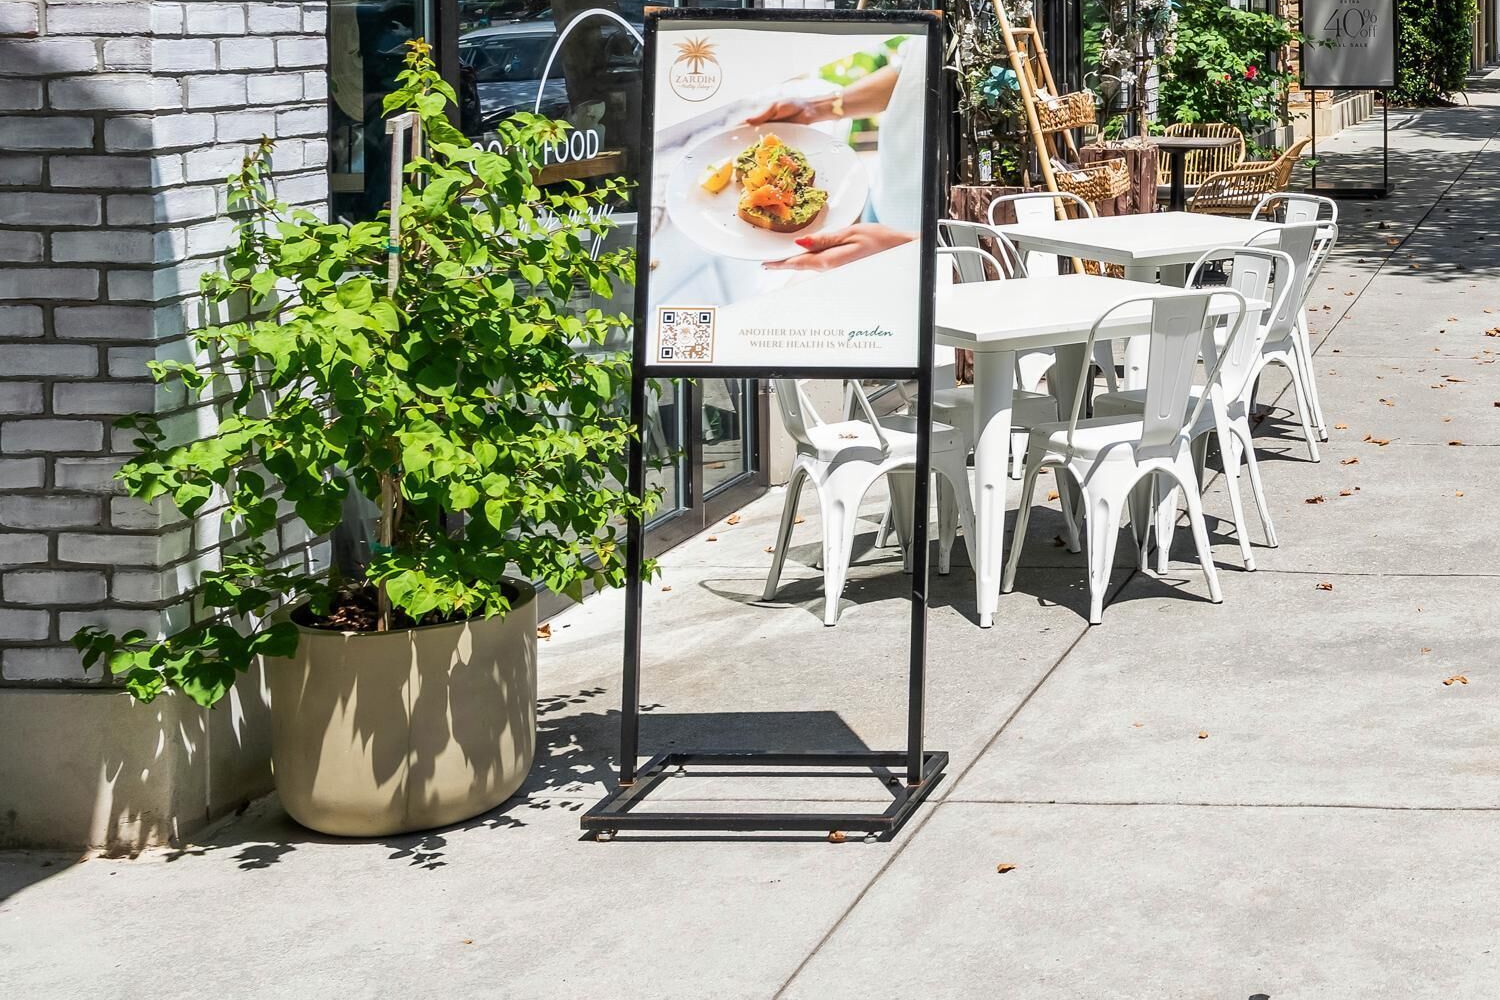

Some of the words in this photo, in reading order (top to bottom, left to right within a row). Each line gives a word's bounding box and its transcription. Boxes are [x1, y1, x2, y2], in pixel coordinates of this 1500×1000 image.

[1360, 24, 1376, 38] off
[676, 75, 716, 84] ZARDIN
[544, 129, 599, 165] FOOD
[738, 328, 786, 337] ANOTHER
[788, 328, 808, 337] DAY
[810, 328, 821, 337] IN
[823, 328, 845, 337] OUR
[847, 325, 894, 342] garden
[750, 340, 784, 349] WHERE
[786, 340, 824, 349] HEALTH
[826, 340, 836, 349] IS
